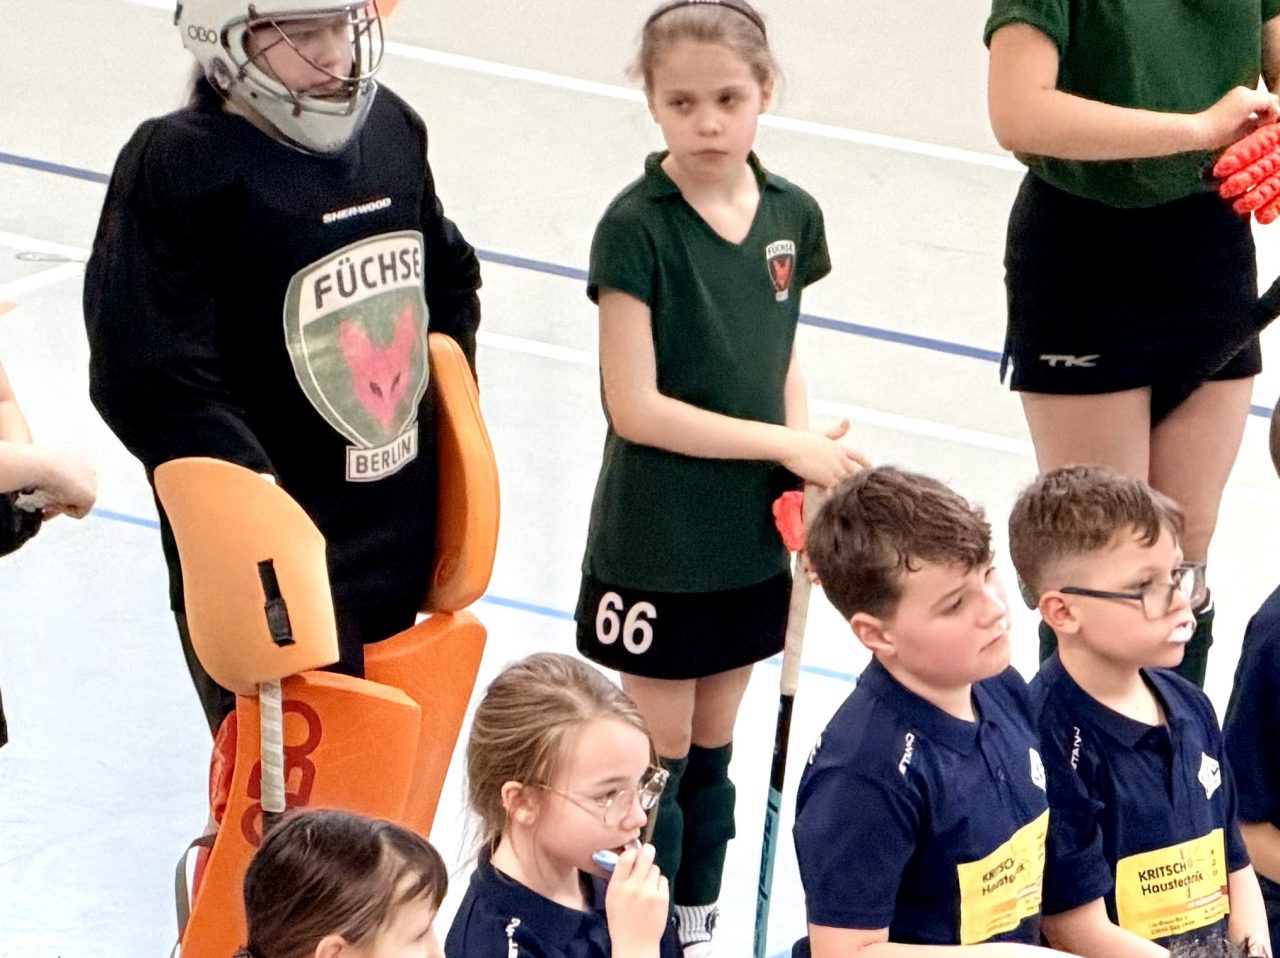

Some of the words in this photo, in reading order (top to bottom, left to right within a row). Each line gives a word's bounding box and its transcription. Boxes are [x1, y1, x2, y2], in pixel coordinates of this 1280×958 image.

[187, 24, 218, 45] OBO
[313, 247, 421, 310] FÜCHSE
[1039, 353, 1101, 368] TK
[356, 435, 412, 474] BERLIN
[595, 591, 658, 655] 66
[1138, 861, 1187, 883] KRITSCH
[1141, 870, 1204, 897] Haustechnik
